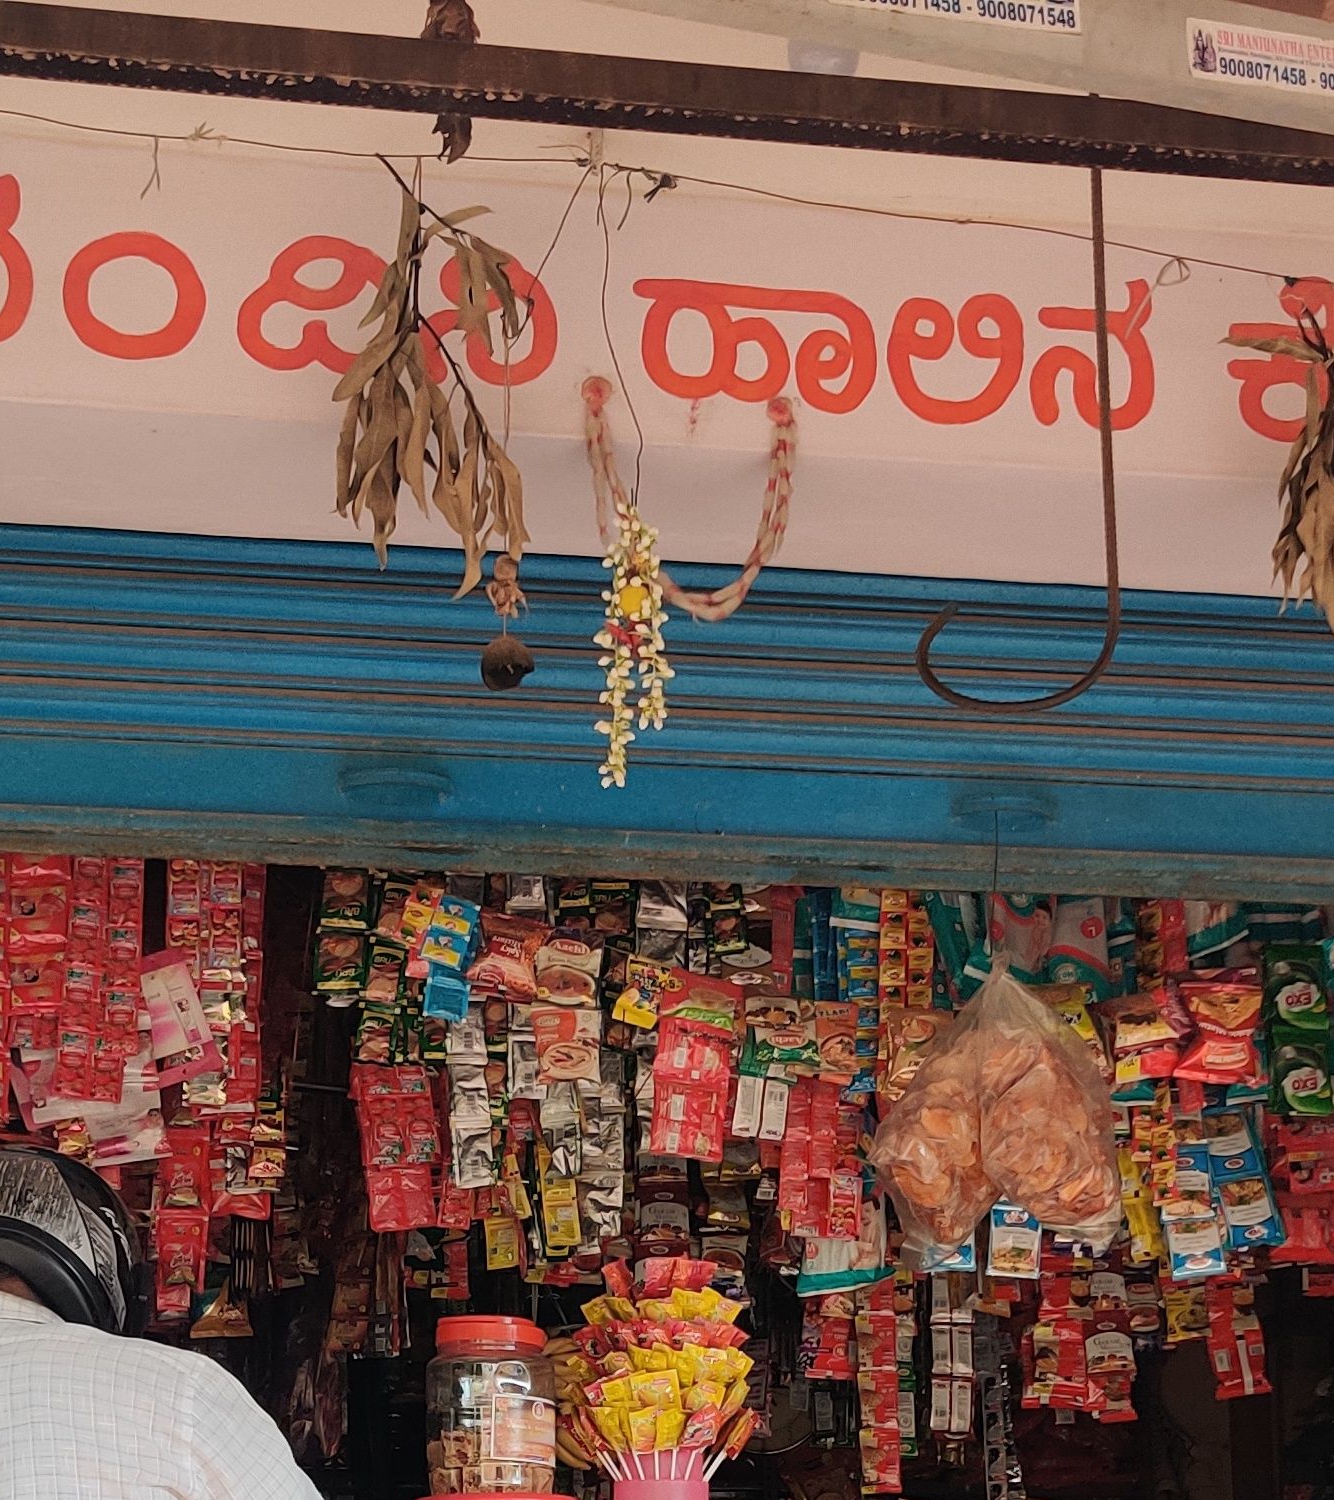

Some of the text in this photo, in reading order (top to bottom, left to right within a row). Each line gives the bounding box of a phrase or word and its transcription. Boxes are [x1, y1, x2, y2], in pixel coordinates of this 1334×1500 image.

[977, 1, 1076, 29] 9008071548
[1219, 56, 1307, 87] 9008071458
[634, 276, 1158, 431] ಹಾಲಿನ
[553, 941, 586, 955] Aachi
